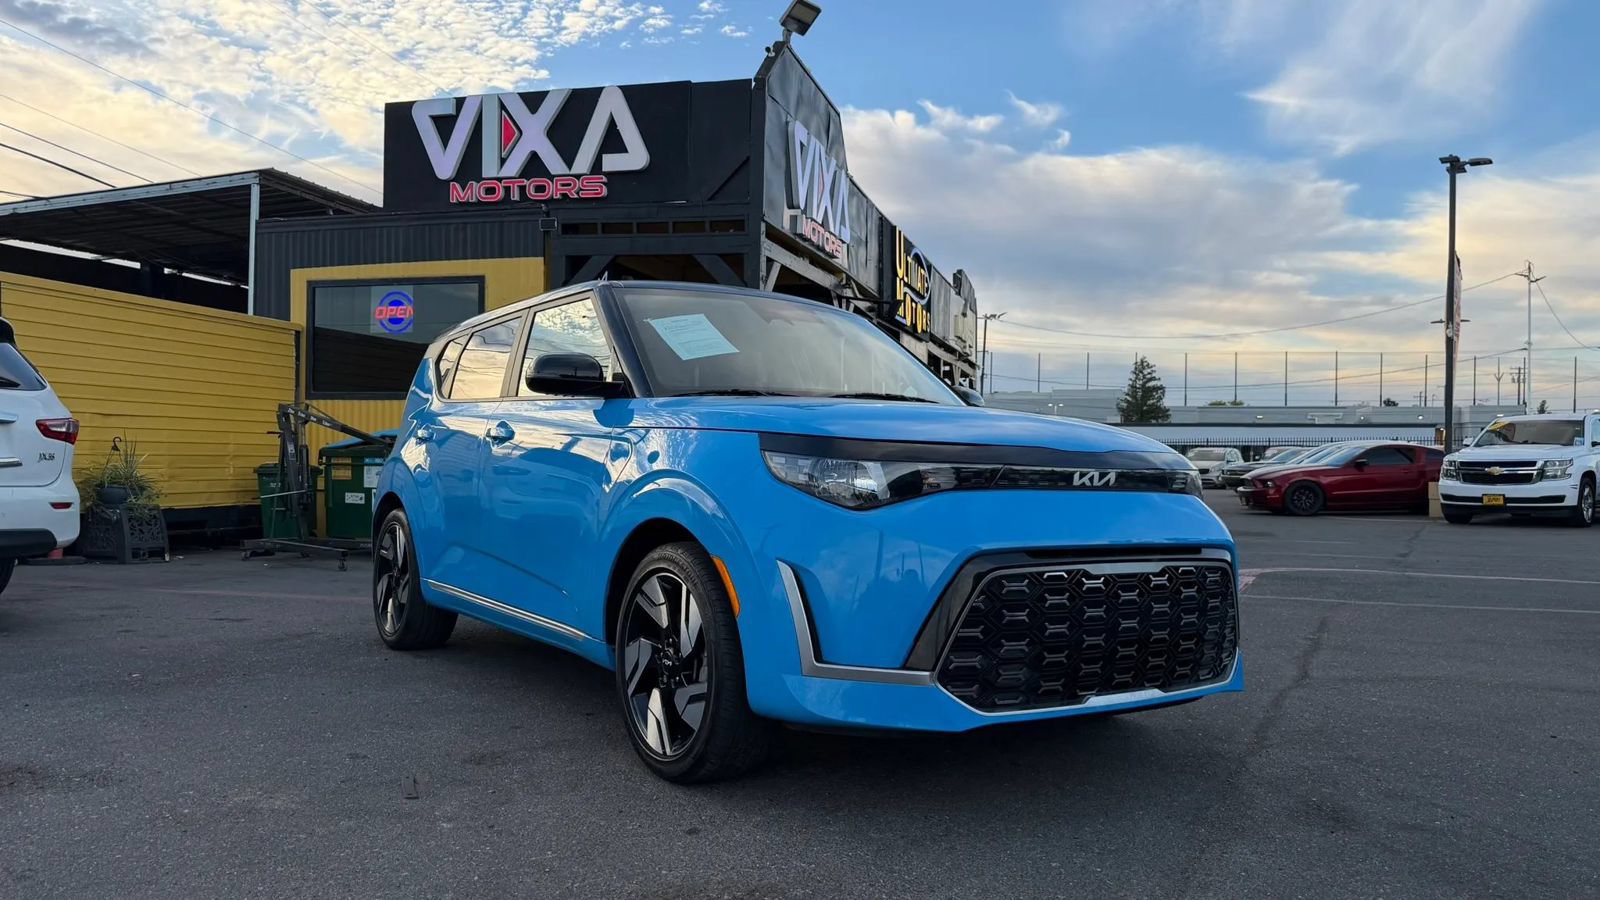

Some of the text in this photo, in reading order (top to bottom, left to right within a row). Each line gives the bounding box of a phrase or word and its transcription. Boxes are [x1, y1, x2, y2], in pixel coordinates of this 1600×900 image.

[411, 84, 650, 180] VIXA
[450, 175, 608, 203] MOTORS
[802, 215, 844, 258] MOTORS
[1072, 471, 1116, 487] KIA
